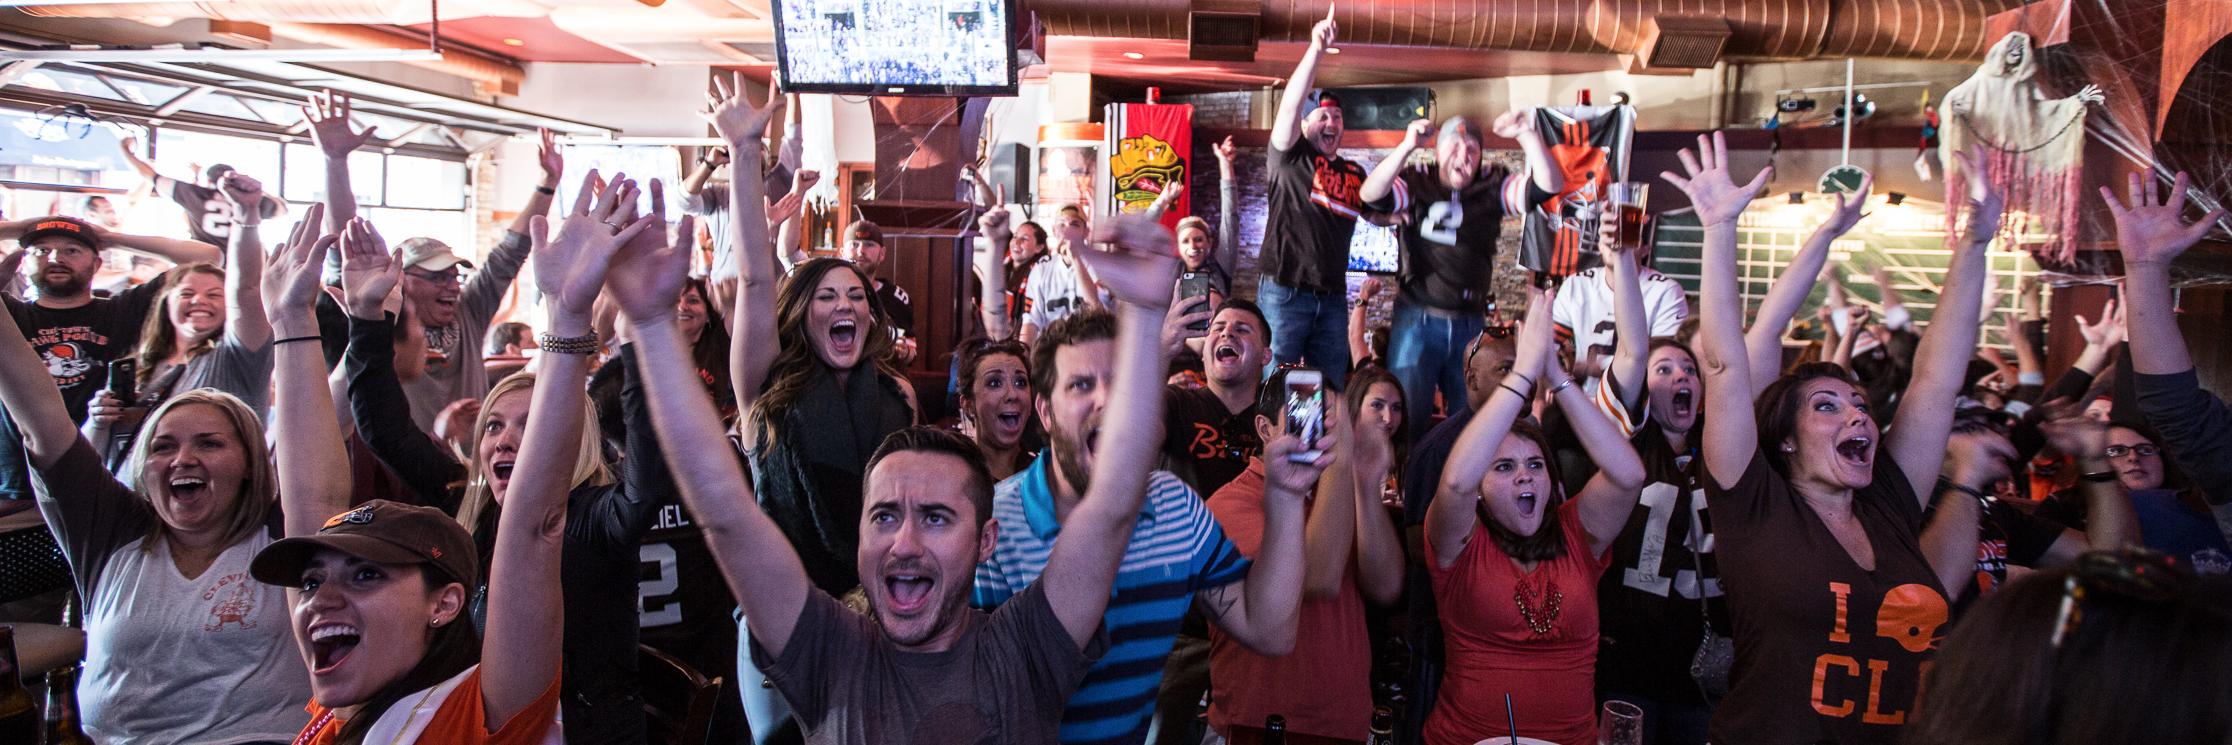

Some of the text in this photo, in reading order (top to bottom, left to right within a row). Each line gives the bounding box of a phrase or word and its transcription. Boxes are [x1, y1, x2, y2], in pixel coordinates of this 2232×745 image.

[202, 199, 231, 238] 2
[1420, 201, 1464, 246] 2
[650, 504, 689, 530] IEL
[1623, 480, 1724, 599] 15
[638, 543, 682, 628] 2
[1829, 581, 1850, 643] I
